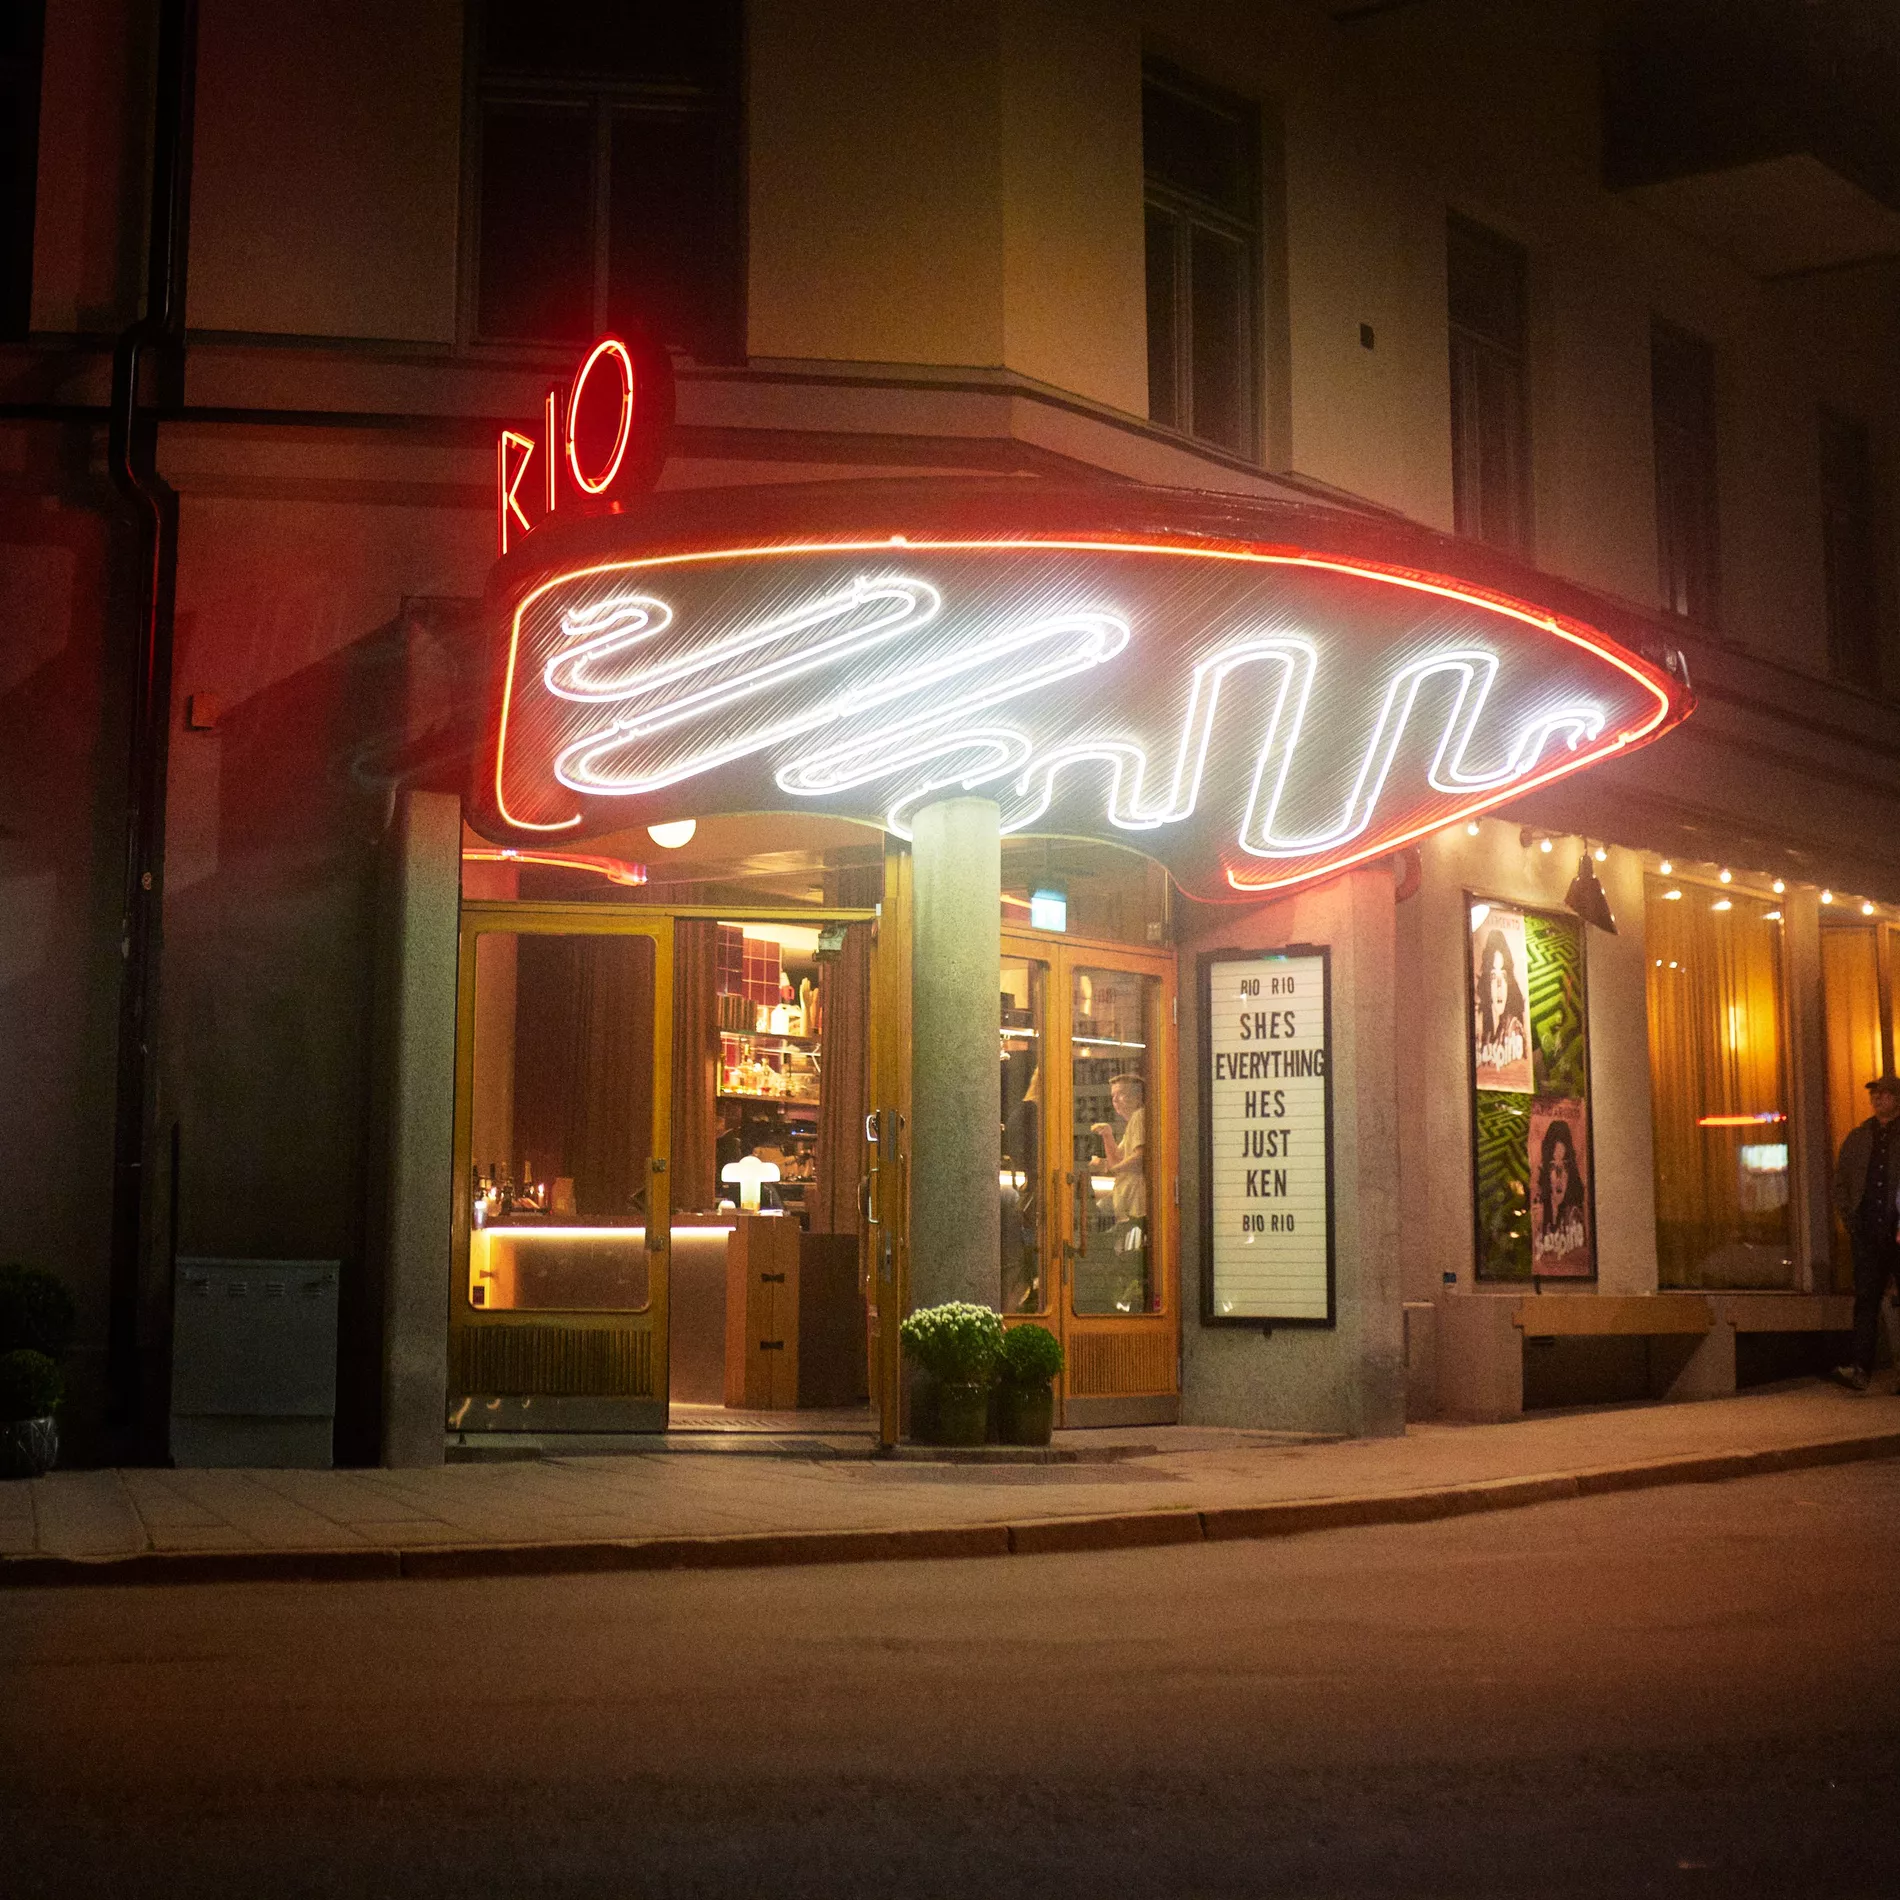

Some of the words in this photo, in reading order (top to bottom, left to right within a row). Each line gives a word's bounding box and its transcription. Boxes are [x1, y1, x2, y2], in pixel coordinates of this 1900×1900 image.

[499, 338, 635, 555] RIO
[1240, 979, 1260, 996] BIO
[1271, 976, 1295, 994] RIO
[1240, 1011, 1295, 1040] SHES
[1215, 1049, 1325, 1080] EVERYTHING
[1245, 1090, 1286, 1118] HES
[1242, 1129, 1291, 1158] JUST
[1246, 1169, 1287, 1198] KEN
[1242, 1214, 1265, 1232] BIO
[1271, 1213, 1294, 1232] RIO
